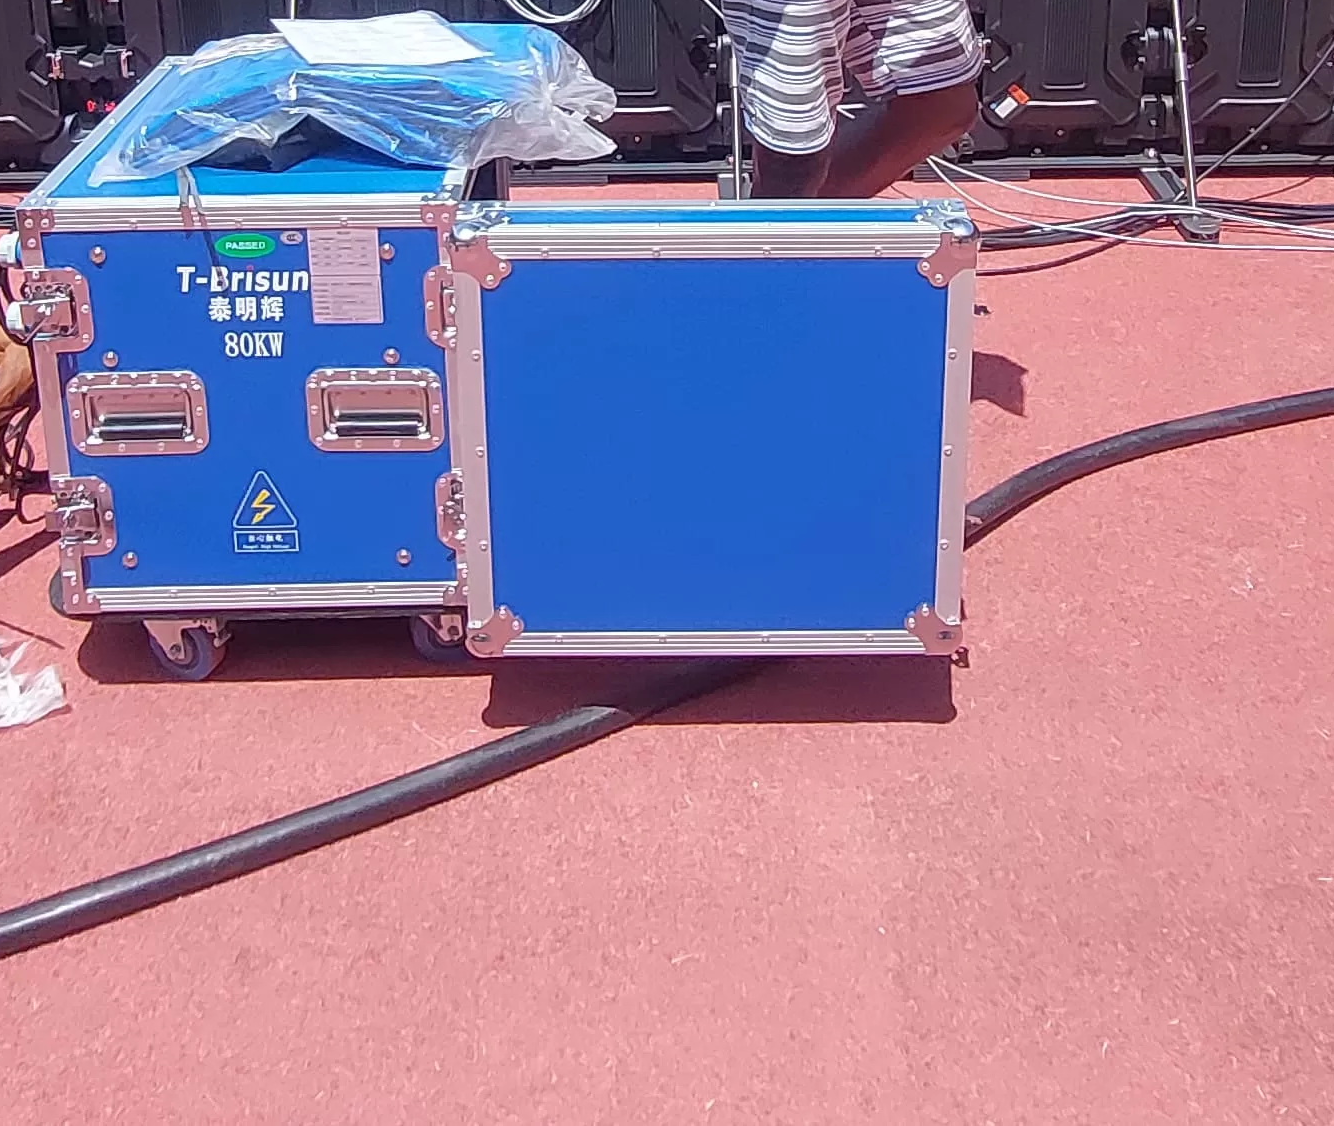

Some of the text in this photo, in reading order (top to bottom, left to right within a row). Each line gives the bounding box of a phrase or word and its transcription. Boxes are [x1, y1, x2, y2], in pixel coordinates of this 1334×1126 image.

[225, 241, 266, 250] PASSED
[176, 265, 310, 293] T-Brisun
[208, 296, 285, 322] 泰明辉
[224, 332, 284, 358] 80KW
